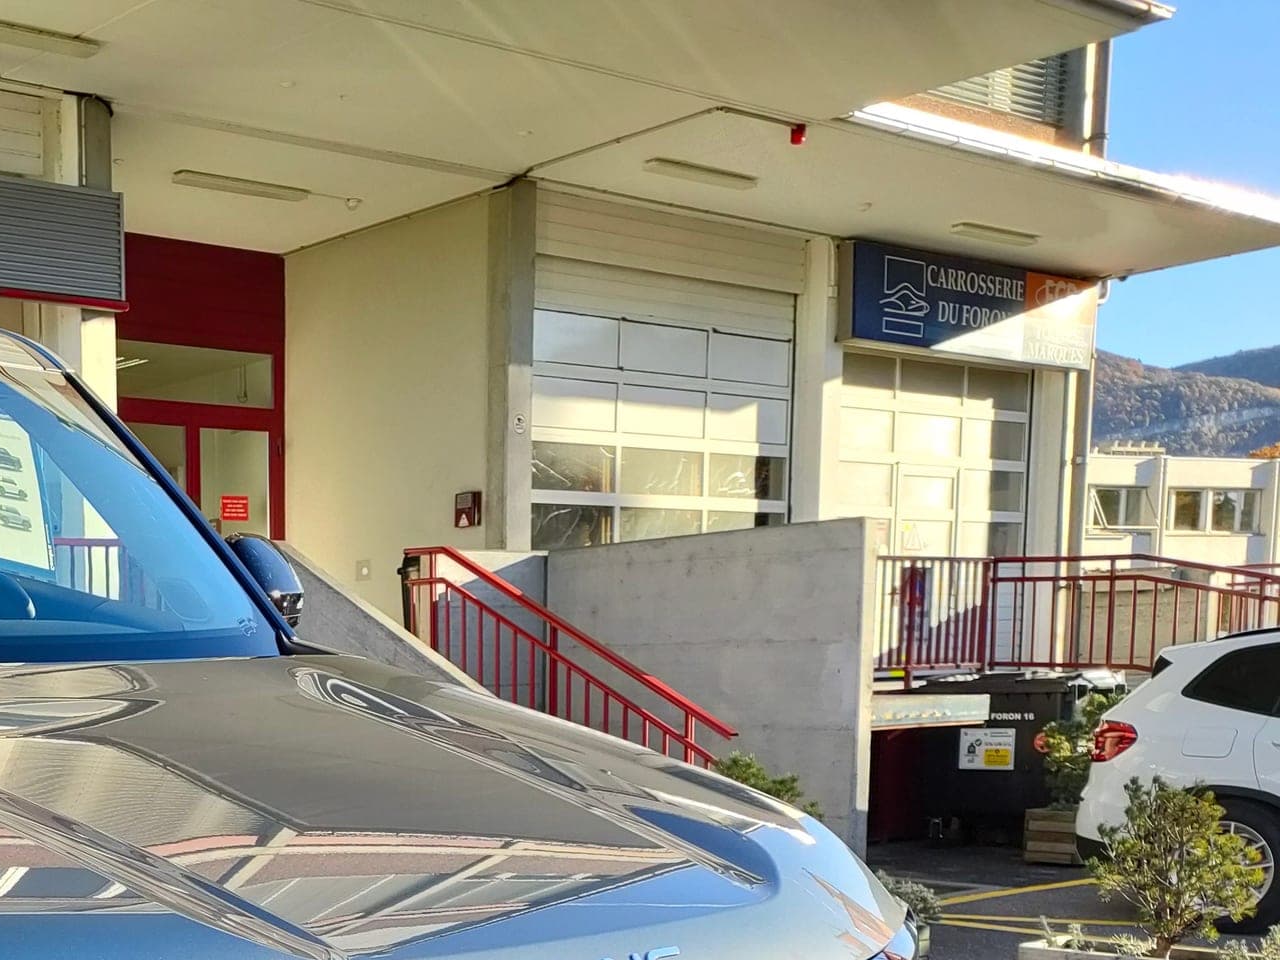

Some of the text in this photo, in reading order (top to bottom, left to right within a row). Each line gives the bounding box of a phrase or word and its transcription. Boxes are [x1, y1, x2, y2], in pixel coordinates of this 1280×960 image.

[927, 265, 1024, 301] CARROSSERIE
[938, 301, 959, 325] DU
[990, 712, 1021, 720] FORON
